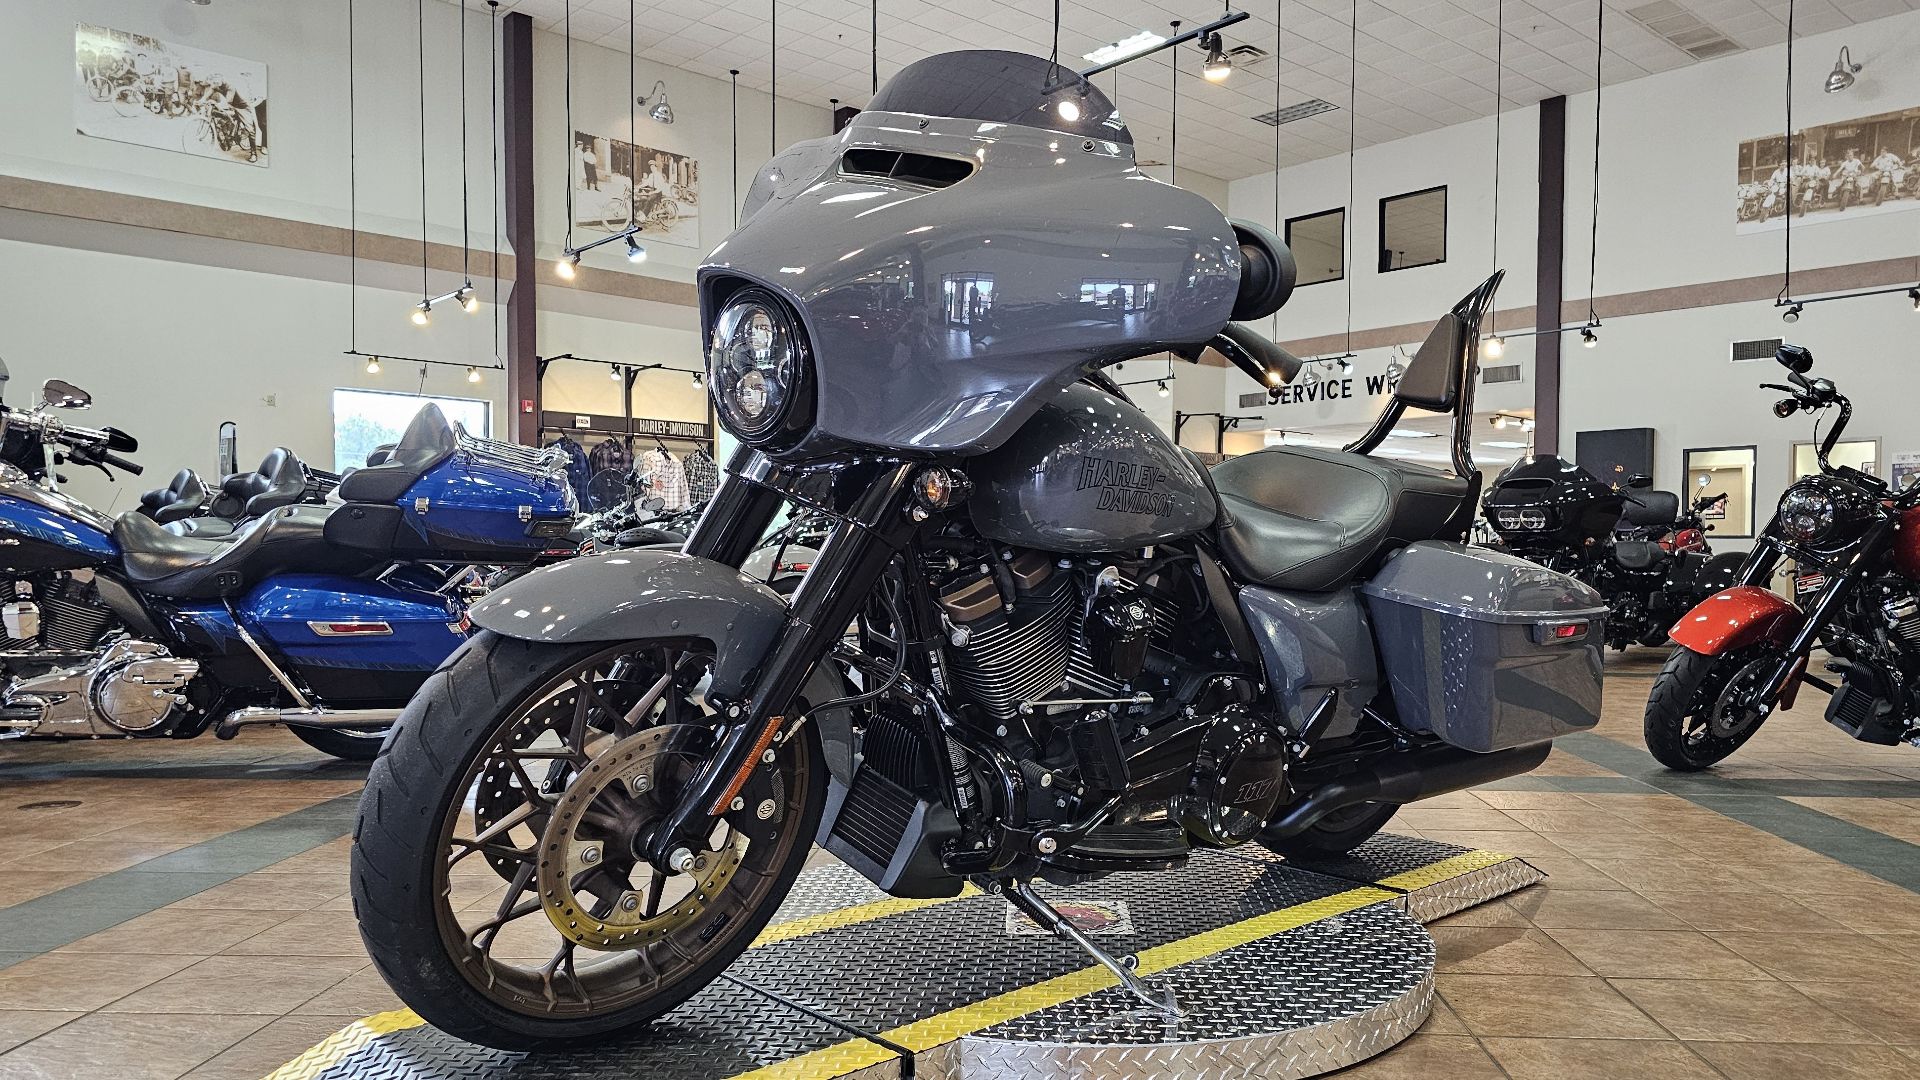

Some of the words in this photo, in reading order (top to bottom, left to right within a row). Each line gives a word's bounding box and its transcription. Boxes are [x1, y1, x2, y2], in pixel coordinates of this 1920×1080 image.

[1267, 379, 1353, 405] SERVICE
[639, 419, 704, 437] HARLEY-DAVIDSON
[1076, 456, 1166, 491] HARLEY-
[1096, 486, 1176, 517] DAVIDSON
[1233, 777, 1278, 804] 117
